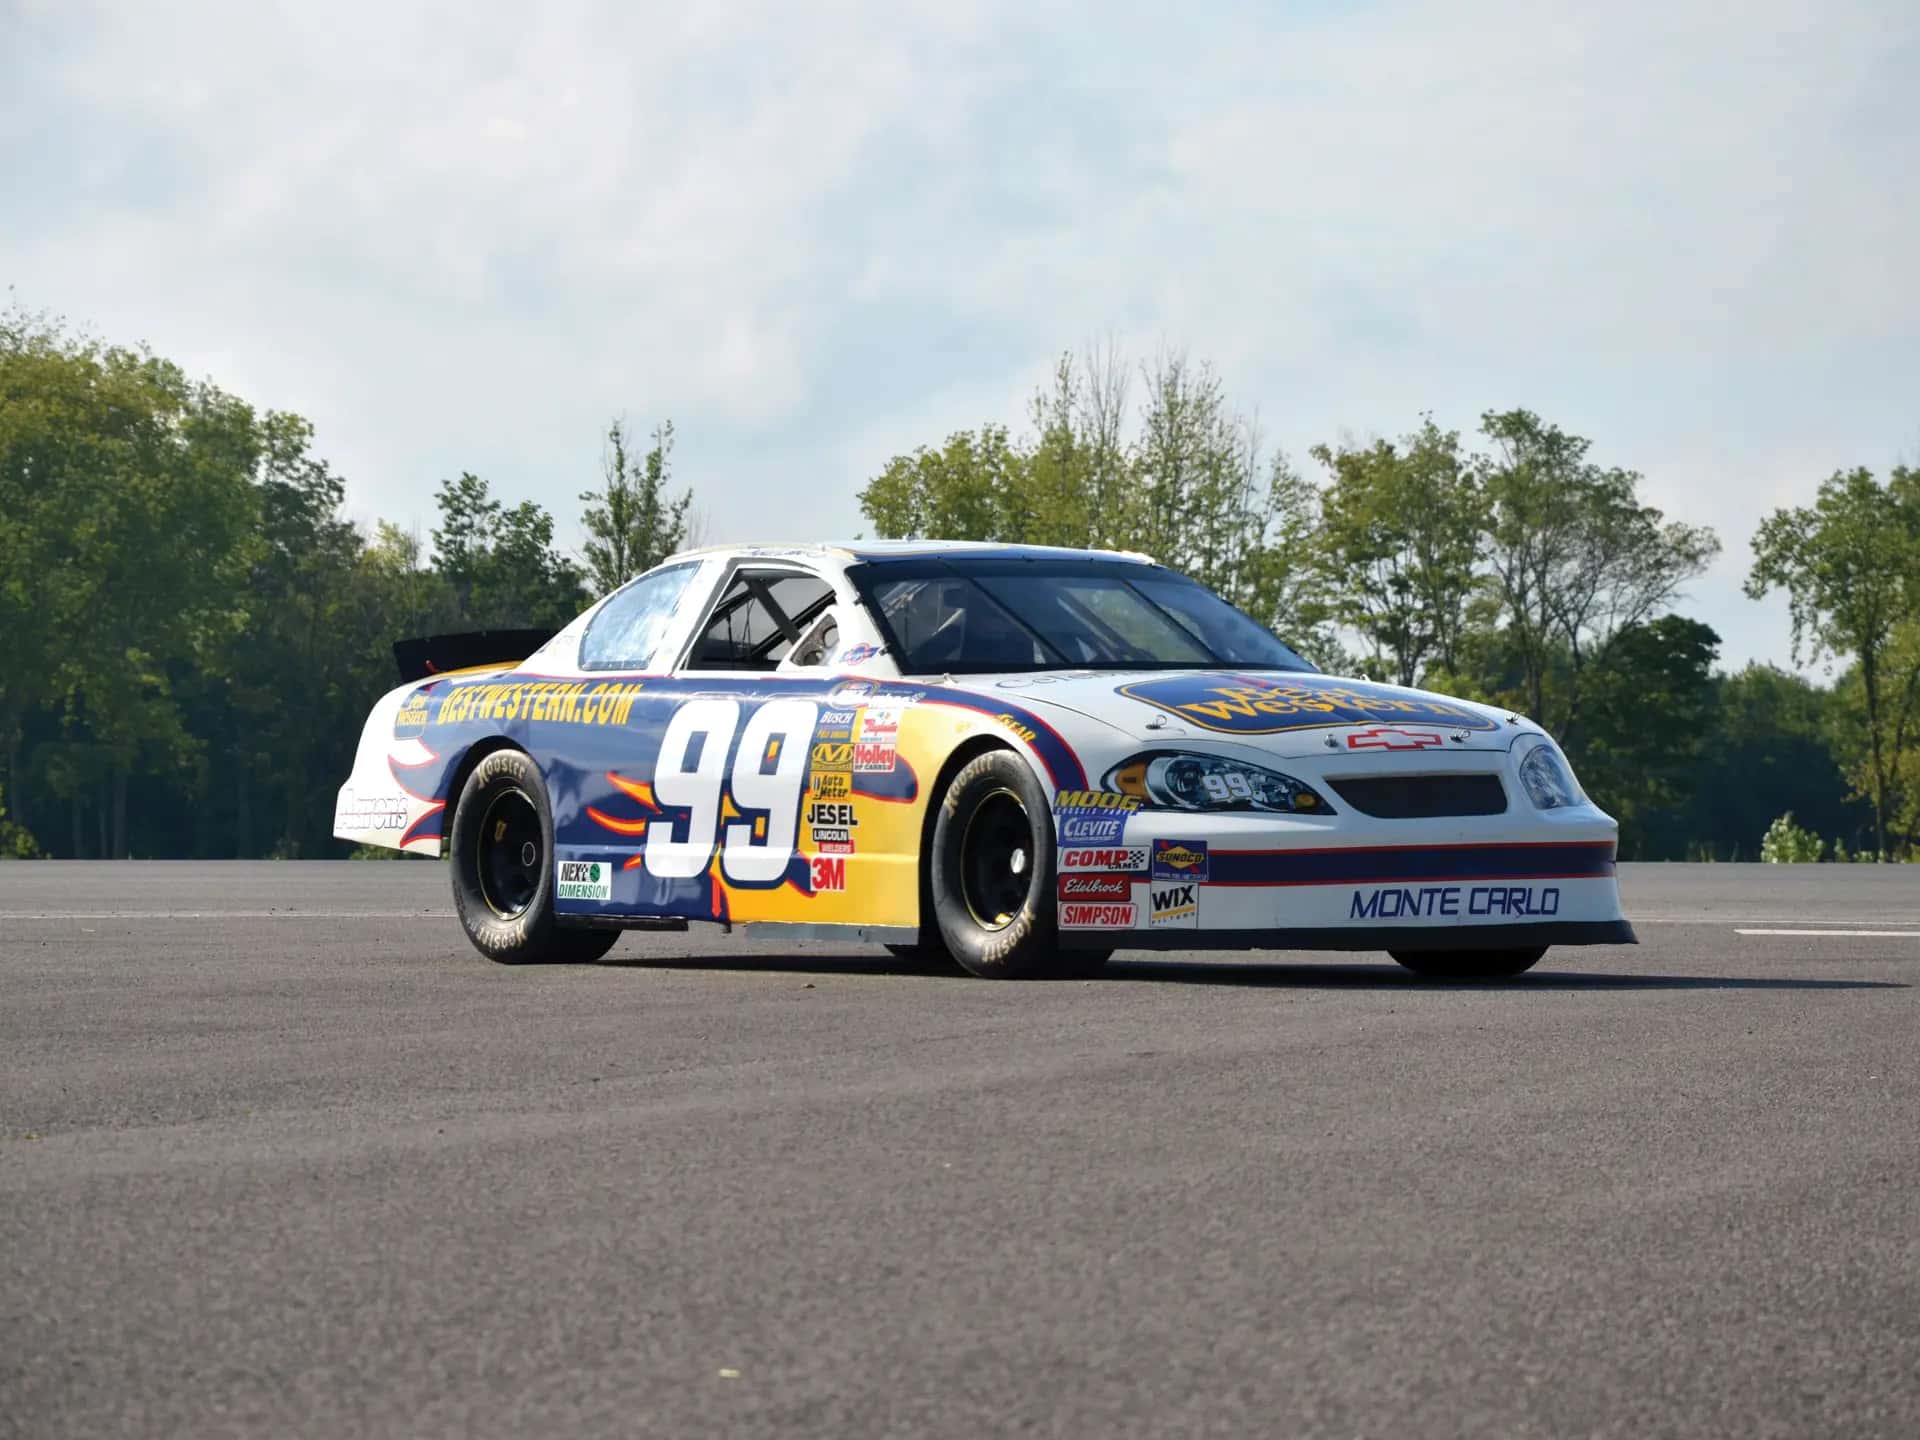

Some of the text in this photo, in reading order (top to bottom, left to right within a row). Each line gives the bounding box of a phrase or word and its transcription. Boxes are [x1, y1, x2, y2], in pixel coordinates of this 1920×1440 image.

[436, 682, 644, 725] BESTWESTERN.COM
[1206, 687, 1373, 702] Best
[1177, 694, 1464, 720] Western
[820, 711, 854, 724] BUSCH
[855, 744, 895, 770] Holley
[645, 698, 818, 881] 99
[1202, 773, 1253, 799] 99
[1055, 790, 1142, 812] MOOG
[807, 804, 858, 826] JESEL
[814, 829, 848, 841] LINCOLN
[1064, 817, 1120, 836] CLEVITE
[1065, 850, 1128, 867] COMP
[1108, 862, 1140, 870] CAMS
[1157, 853, 1203, 863] SUNOCO
[812, 857, 845, 889] 3M
[559, 884, 609, 898] DIMENSION
[1064, 878, 1124, 894] Edelbrock
[1152, 884, 1195, 911] WIX
[1350, 886, 1560, 919] MONTE CARLO
[1064, 906, 1133, 925] SIMPSON
